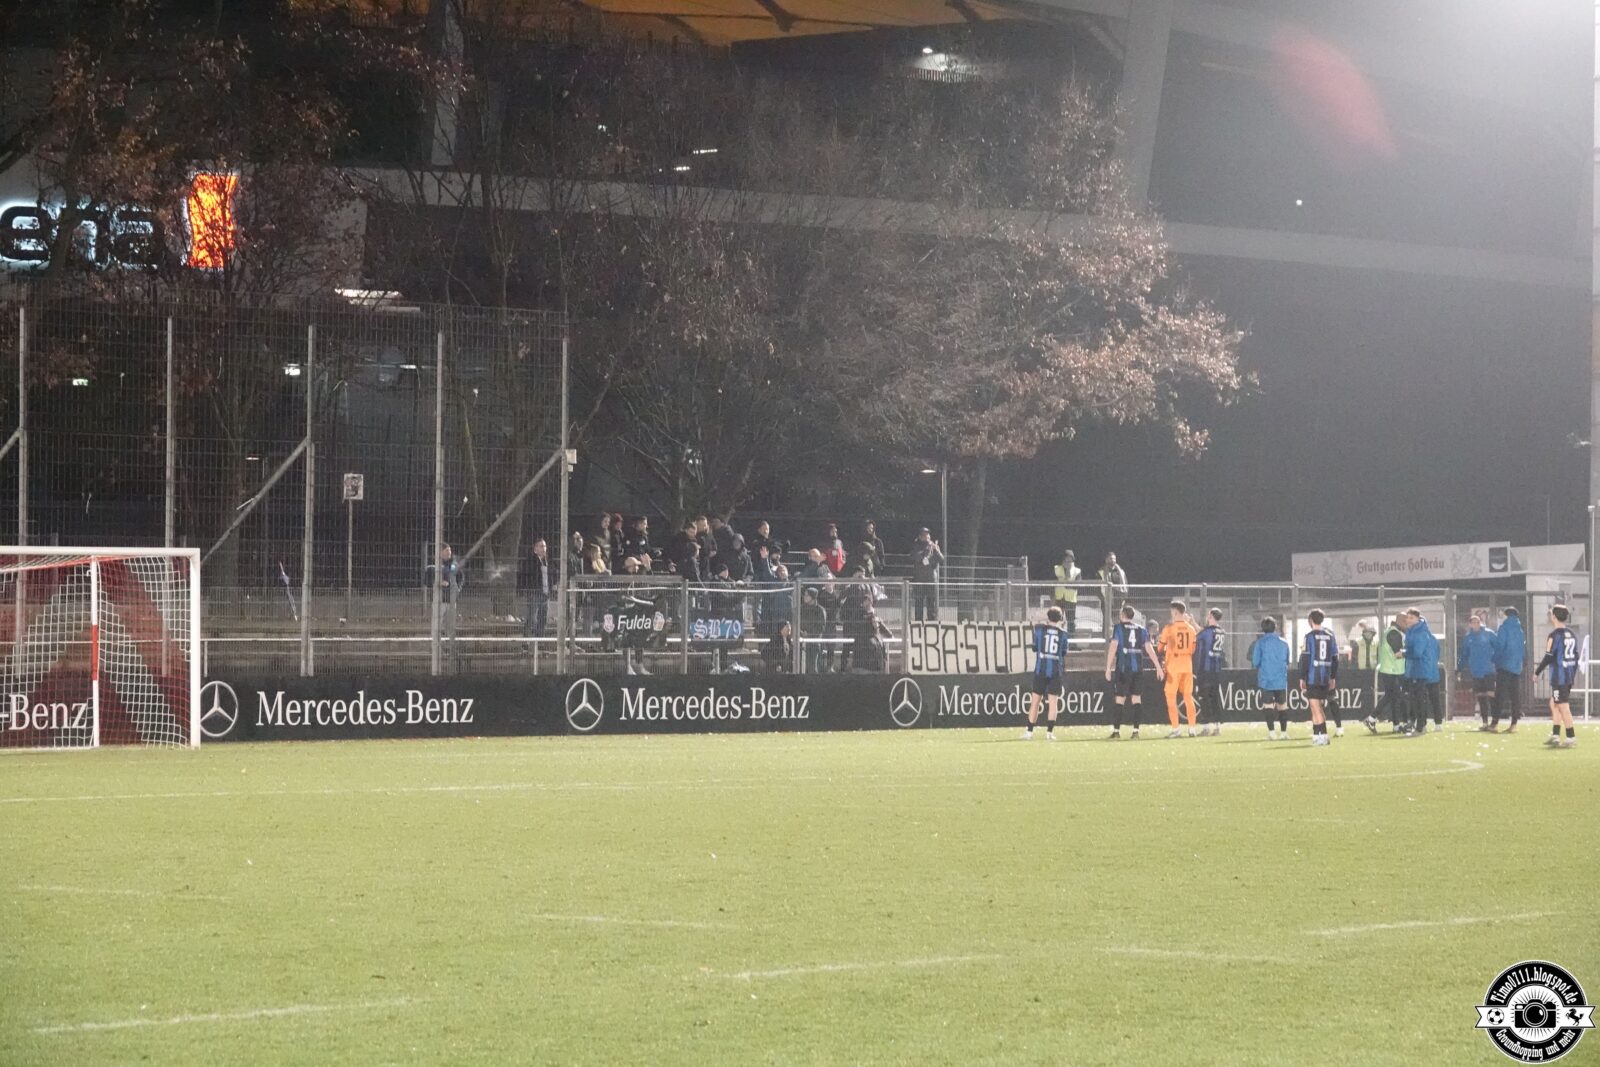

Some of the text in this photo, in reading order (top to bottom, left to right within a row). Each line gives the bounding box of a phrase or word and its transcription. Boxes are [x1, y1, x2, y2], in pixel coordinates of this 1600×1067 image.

[1357, 557, 1445, 574] Stuttgarter Hofbräu
[617, 614, 652, 630] Fulda
[1044, 634, 1059, 654] 16
[1129, 629, 1137, 648] 4
[1177, 632, 1189, 649] 31
[1564, 638, 1576, 659] 22
[1320, 640, 1327, 660] 8
[256, 690, 474, 726] Mercedes-Benz
[619, 687, 810, 720] Mercedes-Benz
